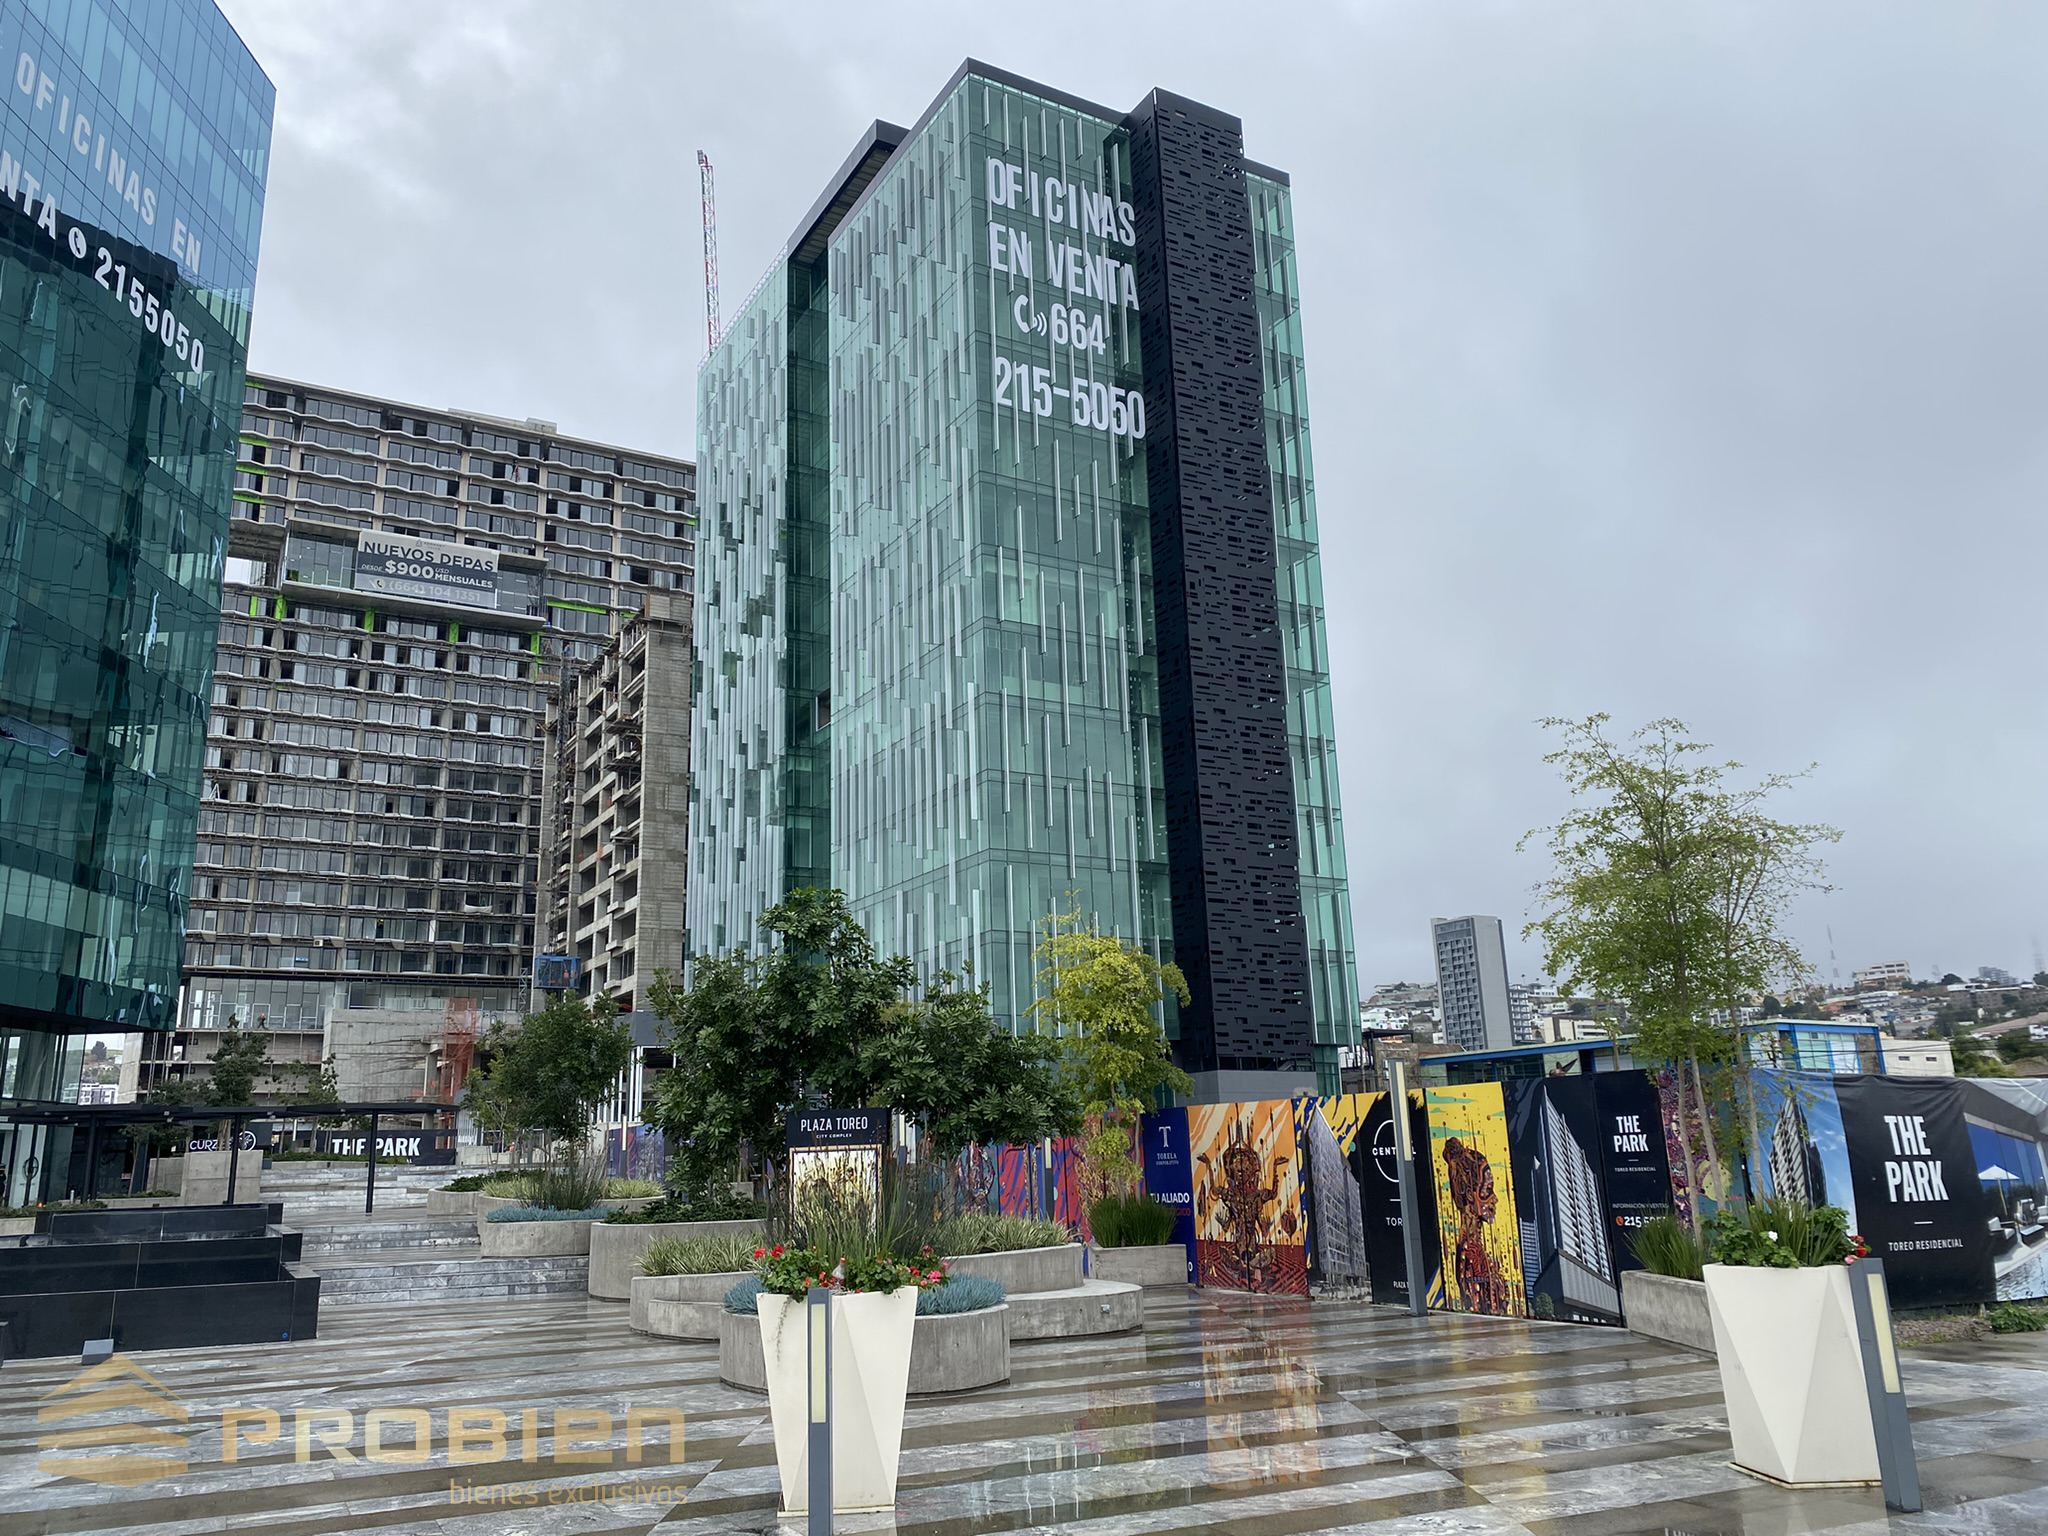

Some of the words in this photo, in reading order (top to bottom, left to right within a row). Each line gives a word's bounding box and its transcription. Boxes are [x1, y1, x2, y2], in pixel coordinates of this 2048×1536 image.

[17, 52, 156, 226] OFICINAS
[172, 217, 201, 274] EN
[989, 158, 1136, 247] OFICINAS
[989, 222, 1029, 279] EN
[1050, 239, 1139, 311] VENTA
[94, 247, 204, 374] 2155050
[1051, 303, 1106, 355] 664
[995, 357, 1146, 439] 215-5050
[364, 541, 434, 563] NUEVOS
[440, 553, 494, 572] DEPAS
[361, 563, 383, 571] DESDE
[385, 559, 434, 579] $900
[389, 580, 425, 595] (664)
[429, 586, 451, 597] 104
[455, 591, 481, 602] 1351
[434, 573, 493, 588] MENSUALES
[800, 1118, 833, 1132] PLAZA
[836, 1116, 868, 1130] TOREO
[1616, 1115, 1641, 1133] THE
[1613, 1134, 1649, 1153] PARK
[1883, 1115, 1932, 1155] THE
[1157, 1152, 1177, 1160] TORELA
[1372, 1147, 1416, 1156] CENTL
[1884, 1161, 1949, 1202] PARK
[1161, 1192, 1190, 1203] ALIADO
[1624, 1216, 1642, 1228] 215
[1888, 1241, 1914, 1251] TOREO
[1916, 1238, 1963, 1250] RESIDENCIAL
